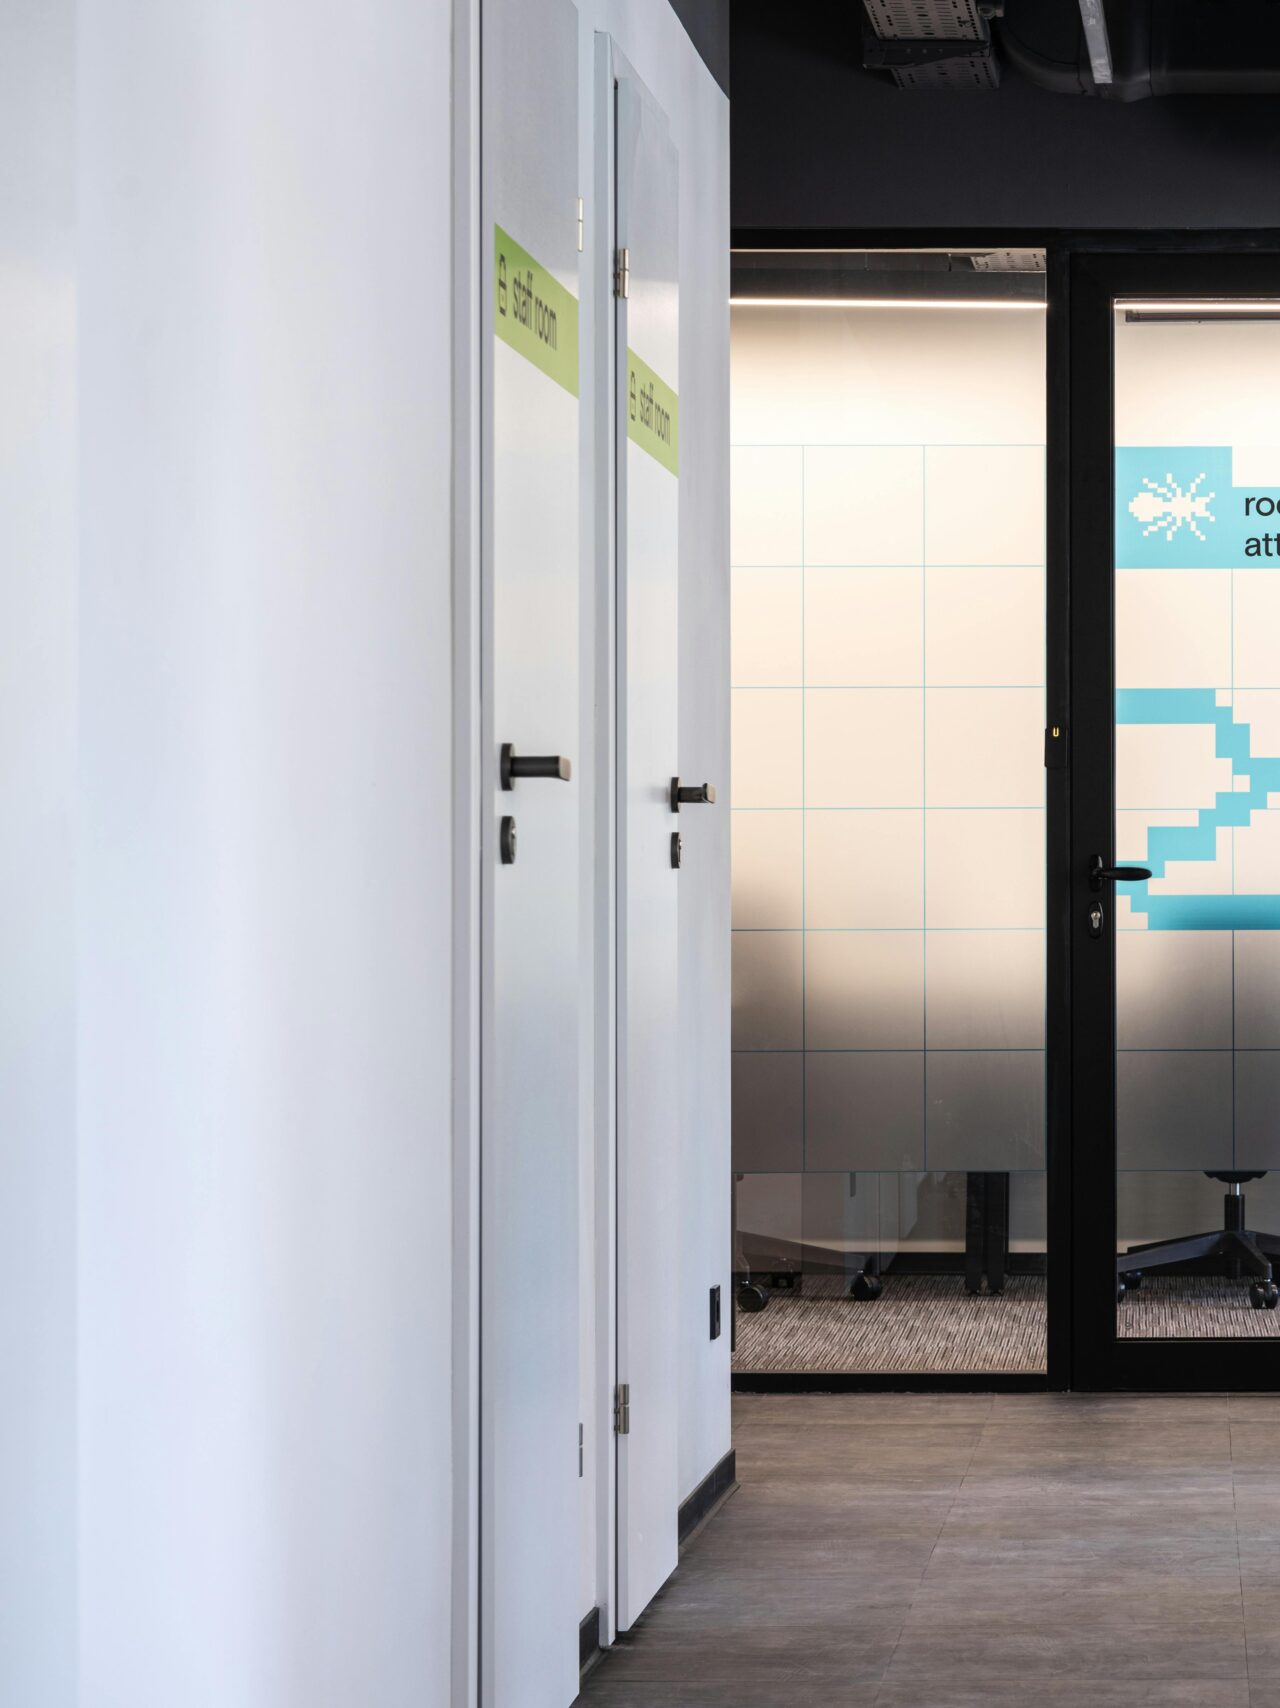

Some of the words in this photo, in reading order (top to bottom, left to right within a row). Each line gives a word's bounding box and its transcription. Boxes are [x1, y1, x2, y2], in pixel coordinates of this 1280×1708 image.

[513, 270, 532, 329] staff
[534, 295, 556, 351] room
[640, 382, 653, 430] staff
[655, 400, 670, 446] room
